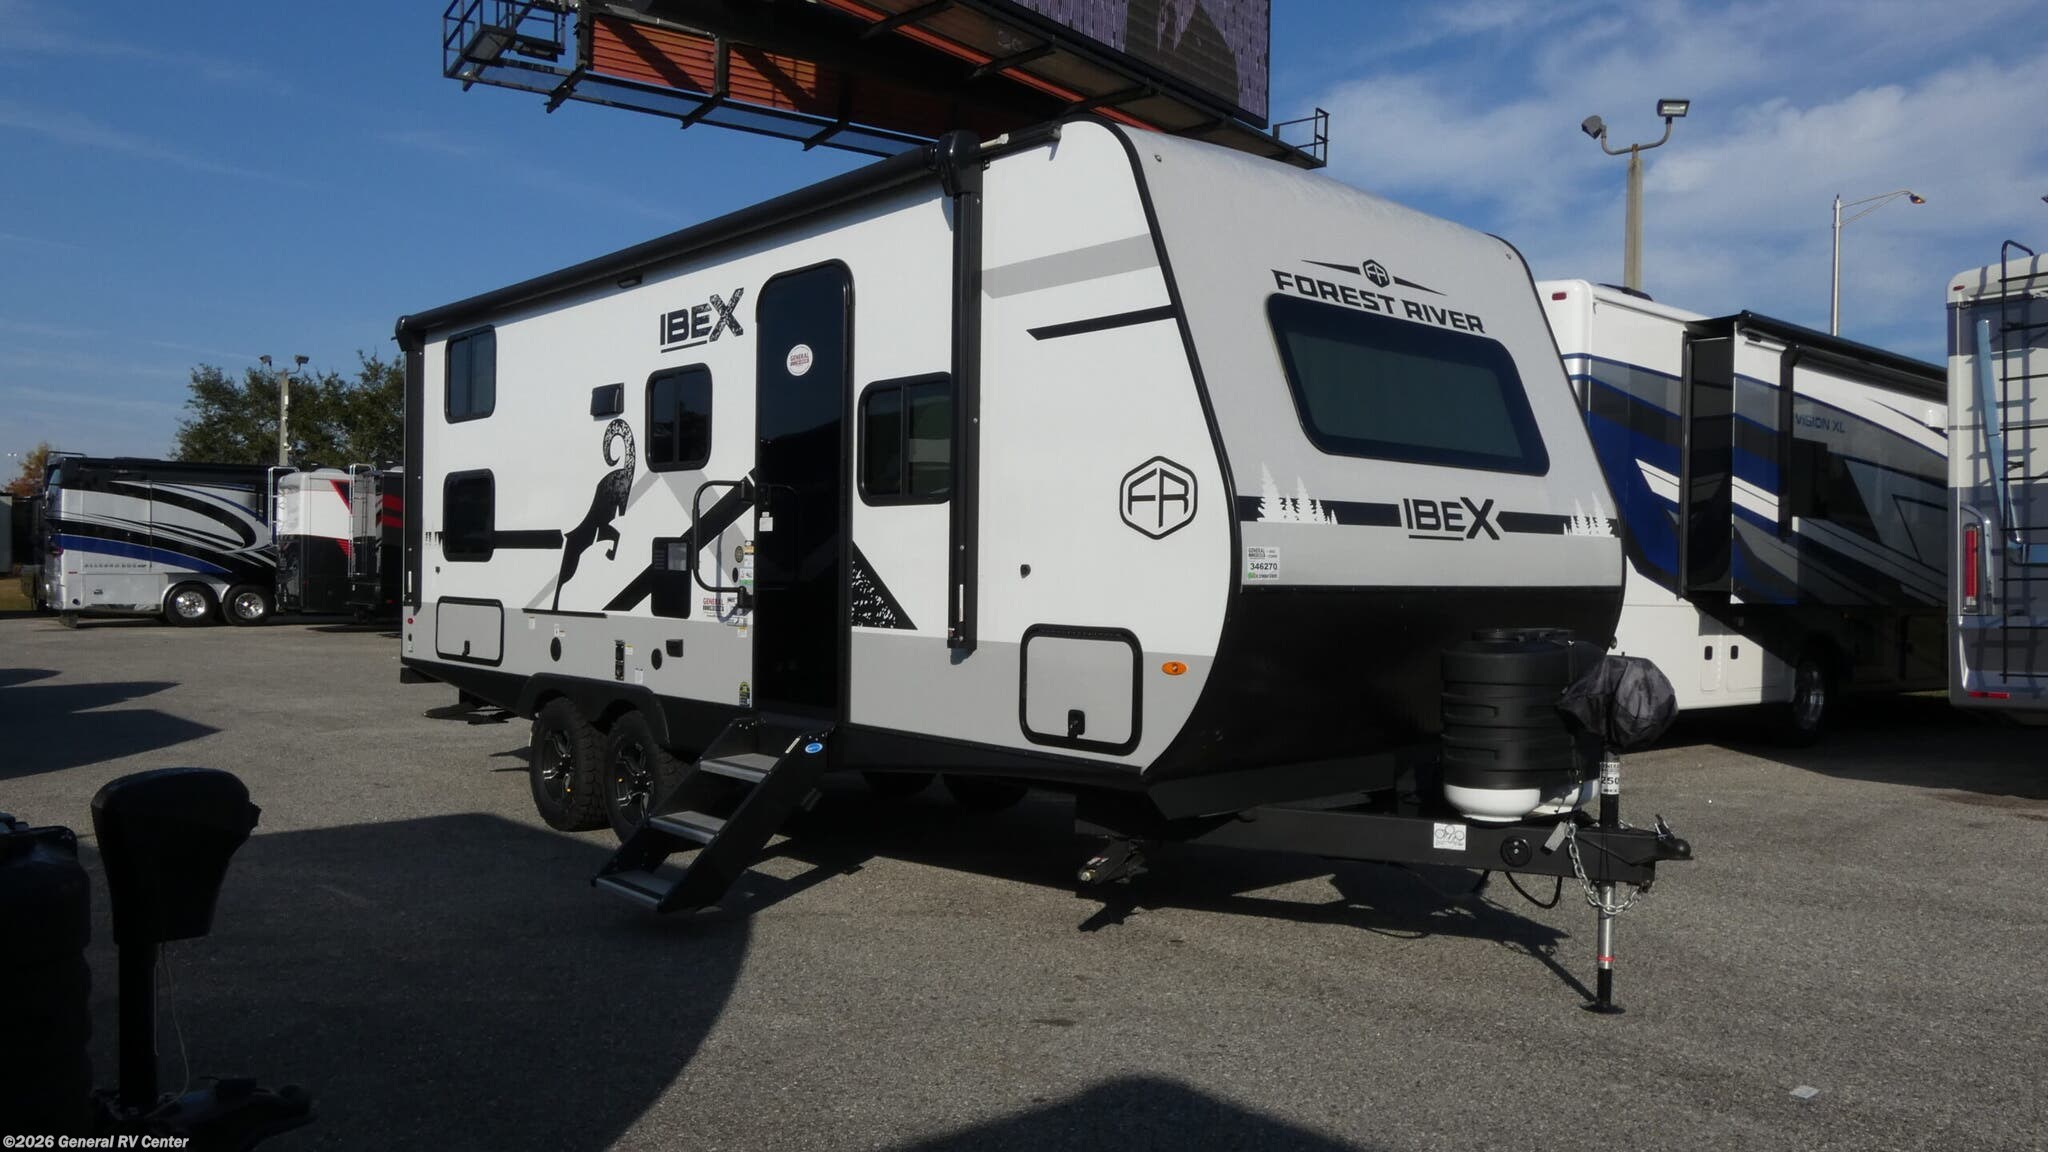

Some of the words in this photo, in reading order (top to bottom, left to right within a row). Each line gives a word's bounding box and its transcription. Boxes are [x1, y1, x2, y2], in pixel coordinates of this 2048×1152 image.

[659, 287, 745, 343] IBEX
[1271, 269, 1395, 314] FOREST
[1401, 299, 1486, 334] RIVER
[1831, 419, 1846, 434] XL
[1403, 496, 1500, 541] IBEX
[1250, 562, 1278, 571] 346270
